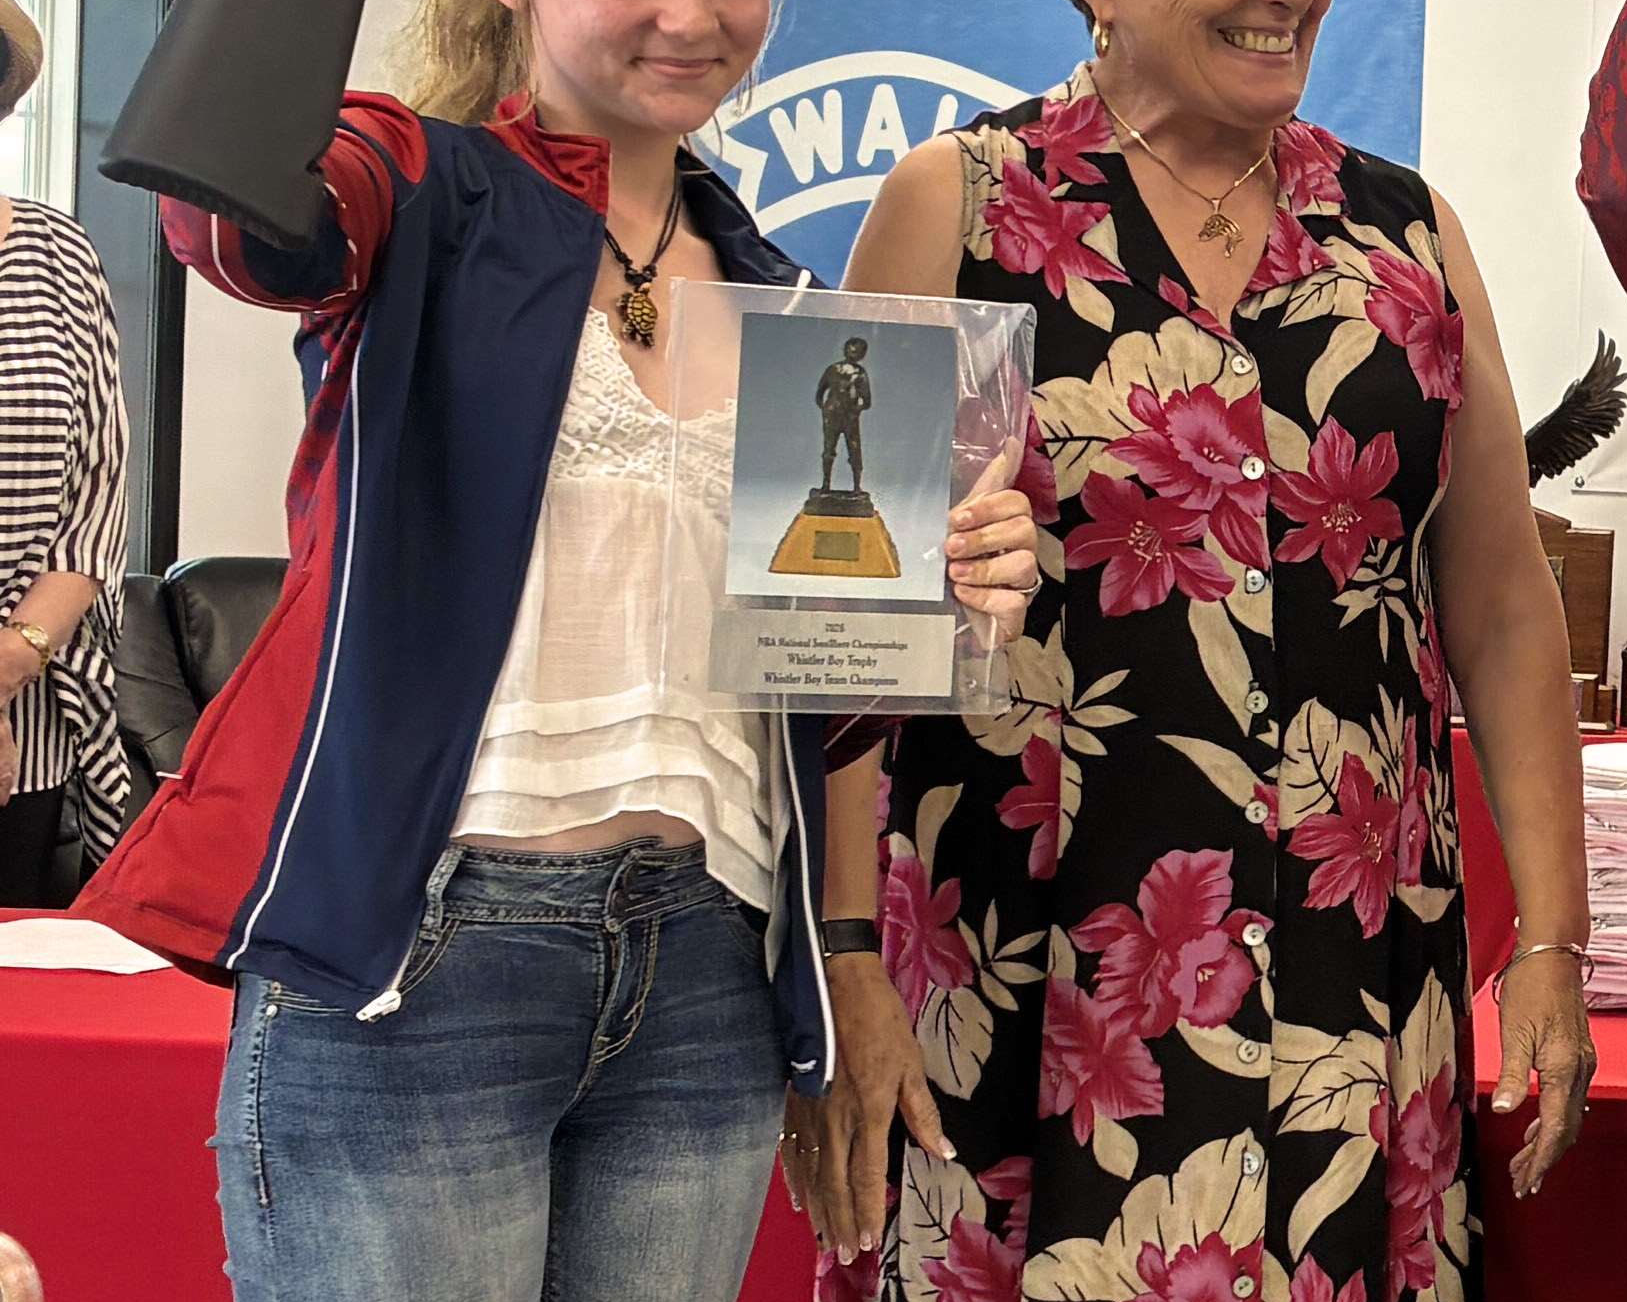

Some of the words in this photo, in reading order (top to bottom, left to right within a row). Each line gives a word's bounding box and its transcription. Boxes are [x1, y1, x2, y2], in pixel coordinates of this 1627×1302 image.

[787, 653, 825, 666] Whistler
[828, 654, 844, 667] Boy
[848, 655, 877, 669] Trophy
[764, 672, 801, 685] Whistler
[804, 673, 822, 686] Boy
